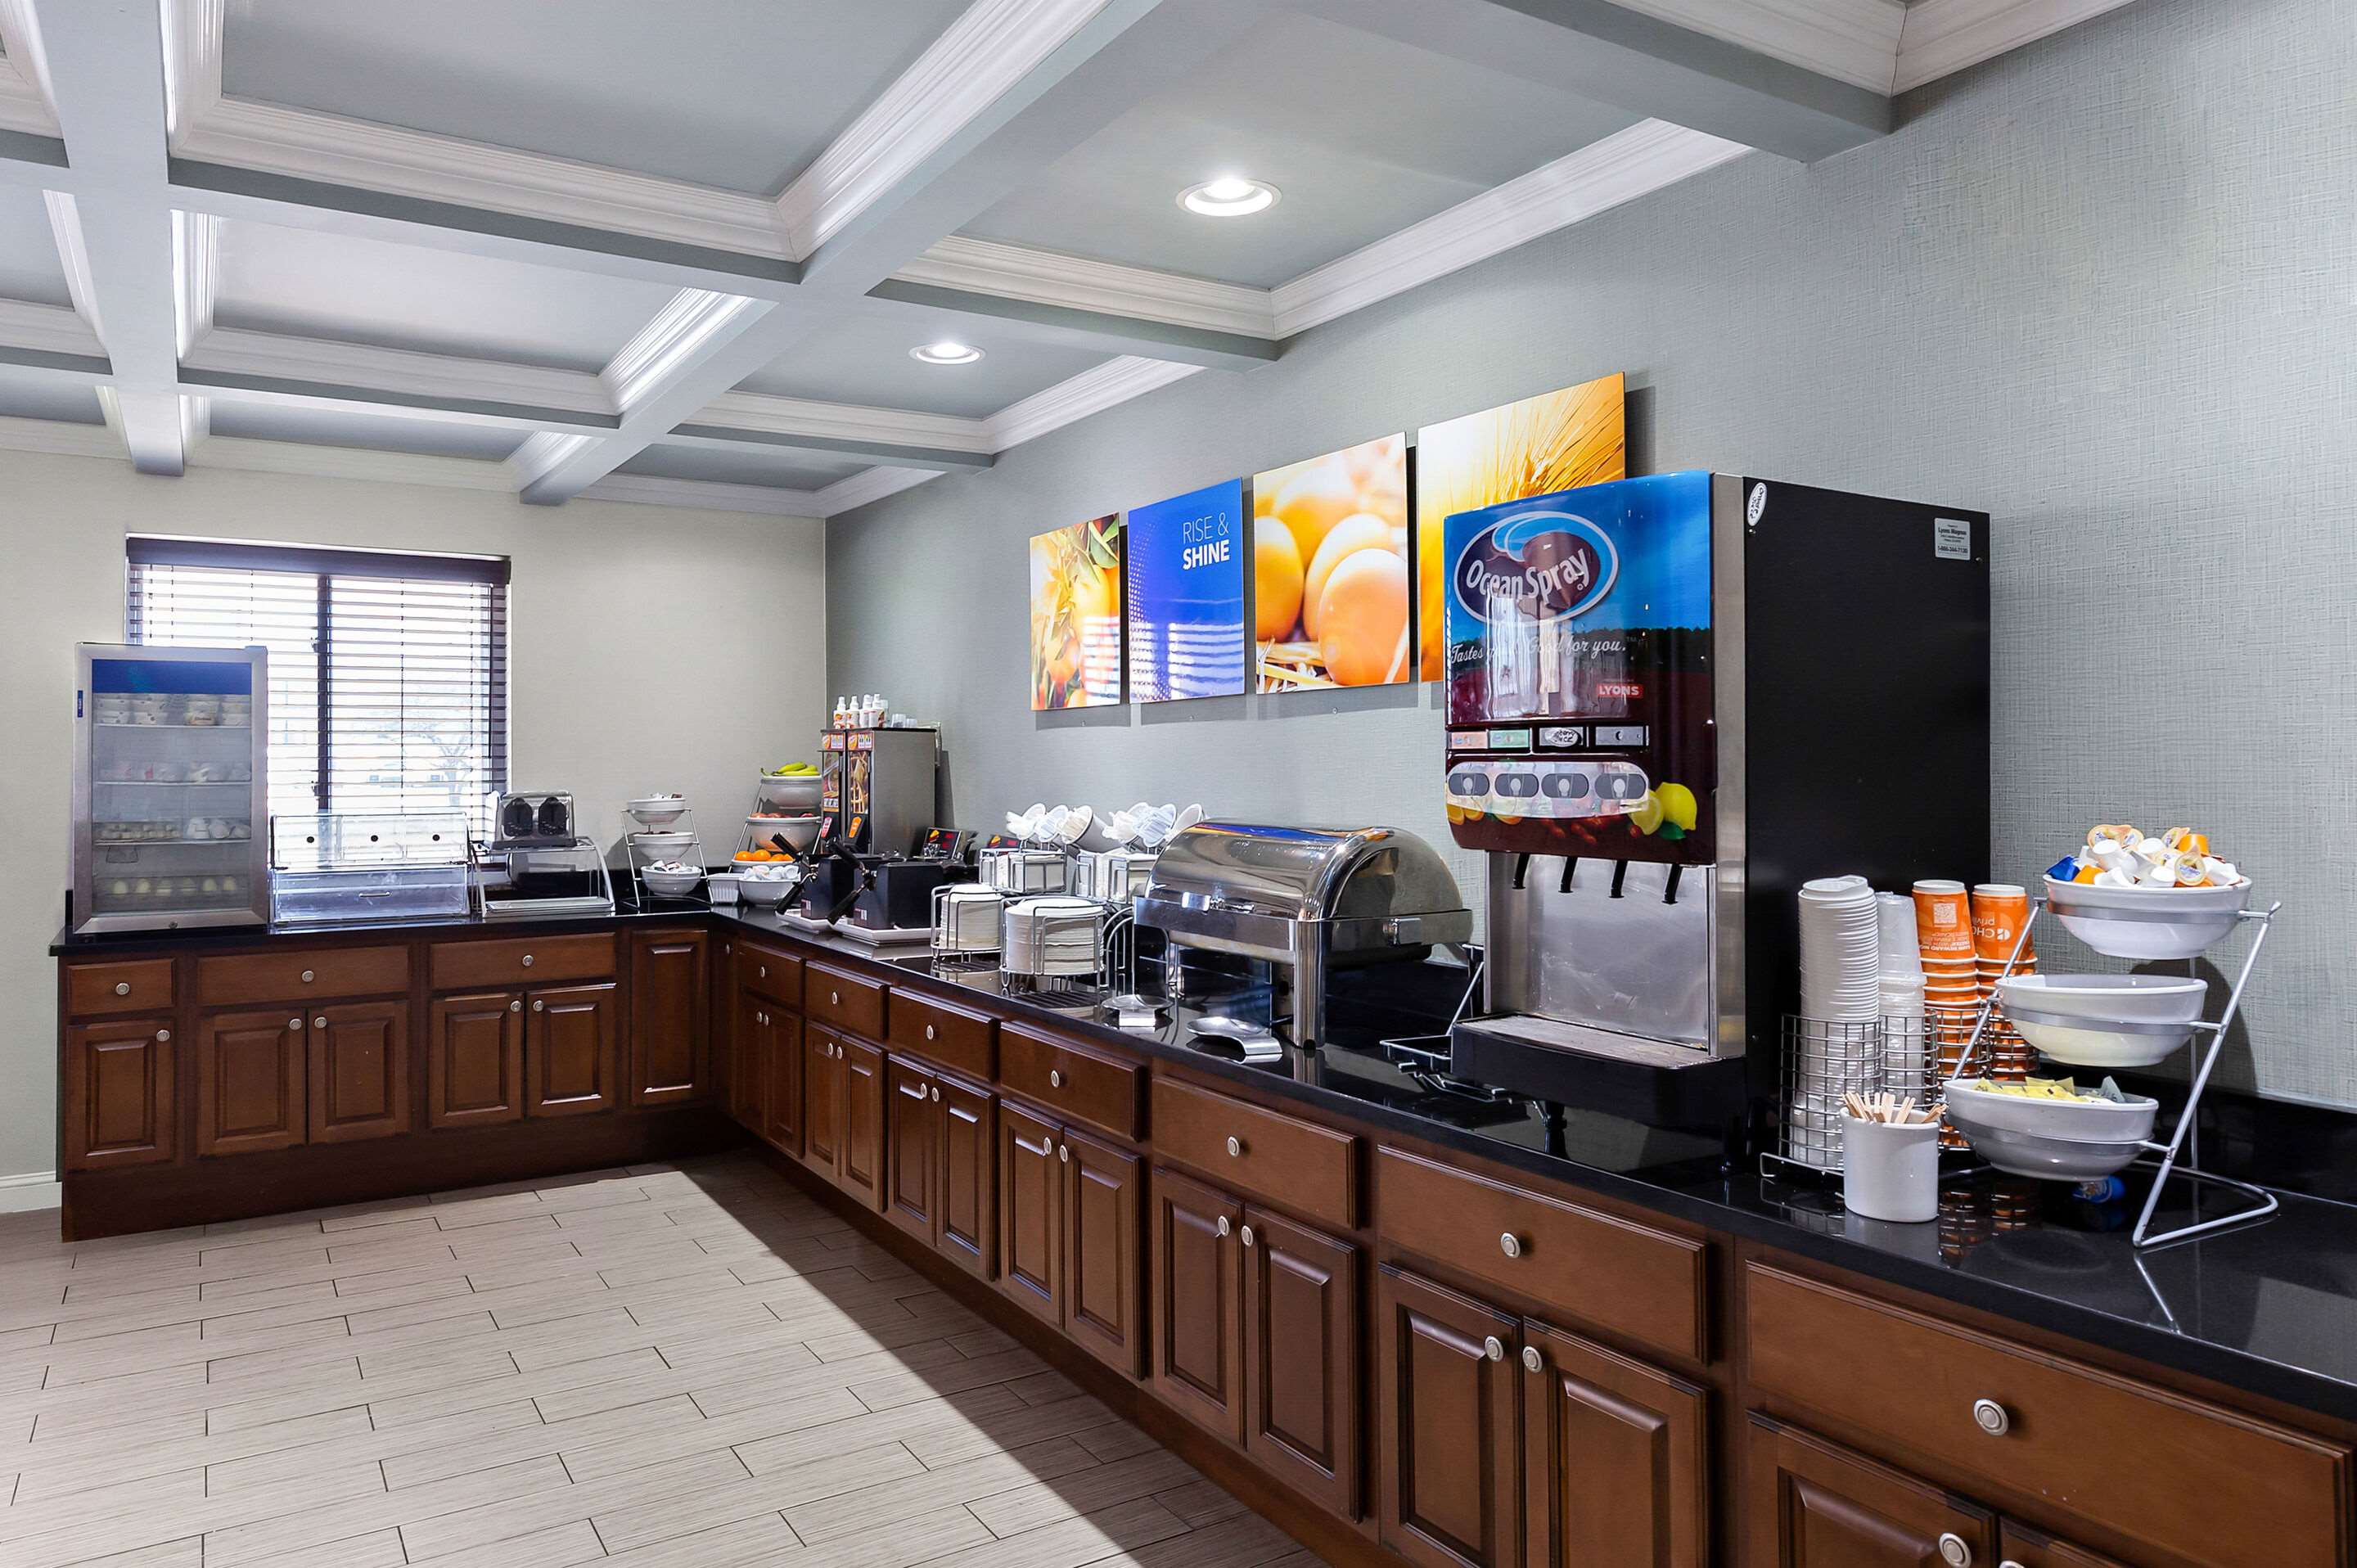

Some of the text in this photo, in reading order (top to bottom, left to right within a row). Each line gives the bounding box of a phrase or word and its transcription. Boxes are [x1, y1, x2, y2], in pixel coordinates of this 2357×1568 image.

[1183, 512, 1229, 544] RISE &
[1183, 539, 1230, 570] SHINE
[1467, 548, 1590, 606] Ocean Spray
[1450, 644, 1483, 664] Tastes
[1565, 636, 1589, 655] for
[1591, 641, 1626, 660] you.
[1599, 685, 1639, 696] LYONS
